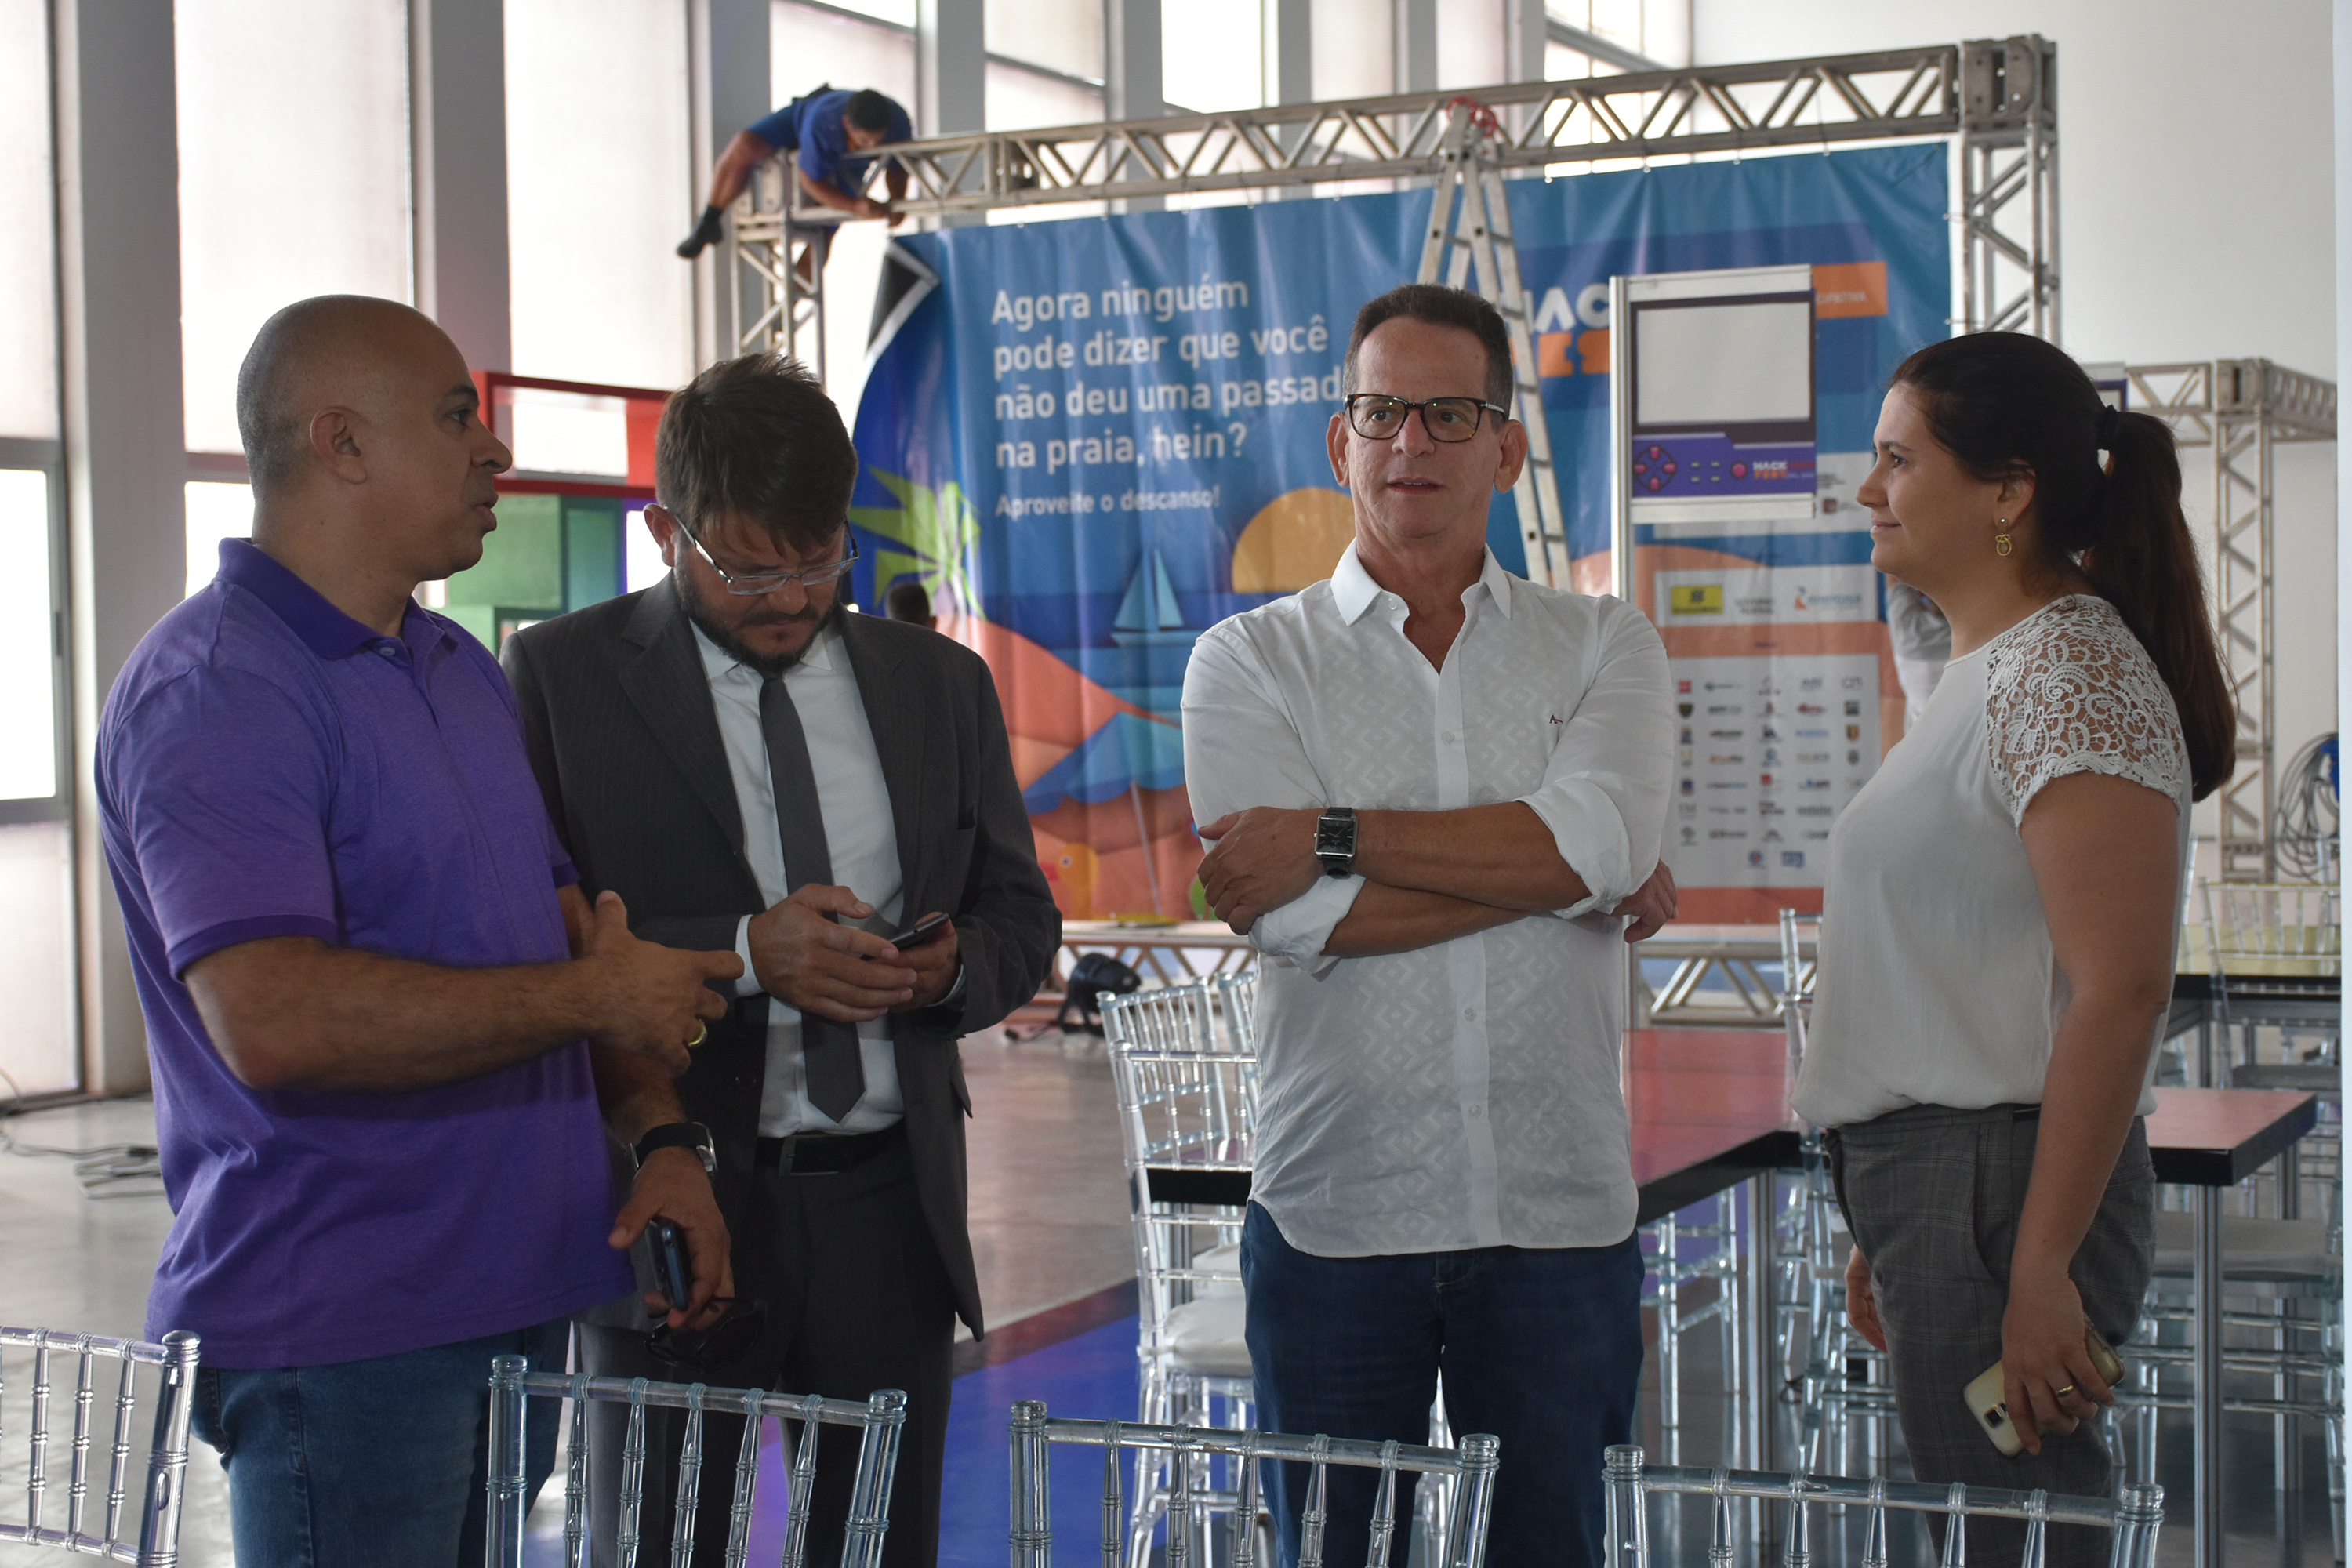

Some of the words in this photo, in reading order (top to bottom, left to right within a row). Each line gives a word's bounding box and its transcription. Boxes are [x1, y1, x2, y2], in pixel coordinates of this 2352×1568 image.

[991, 289, 1091, 332] Agora
[1102, 274, 1248, 322] ninguém
[993, 336, 1074, 381] pode
[1084, 331, 1167, 367] dizer
[1180, 333, 1240, 372] que
[1250, 314, 1330, 357] você
[996, 385, 1055, 420] não
[1065, 381, 1127, 416] deu
[1139, 386, 1211, 412] uma
[1221, 365, 1341, 418] passad
[996, 441, 1036, 469] na
[1047, 428, 1145, 475] praia,
[1152, 423, 1247, 462] hein?
[995, 490, 1094, 521] Aproveite
[1101, 496, 1114, 511] o
[1120, 485, 1221, 514] descanso!
